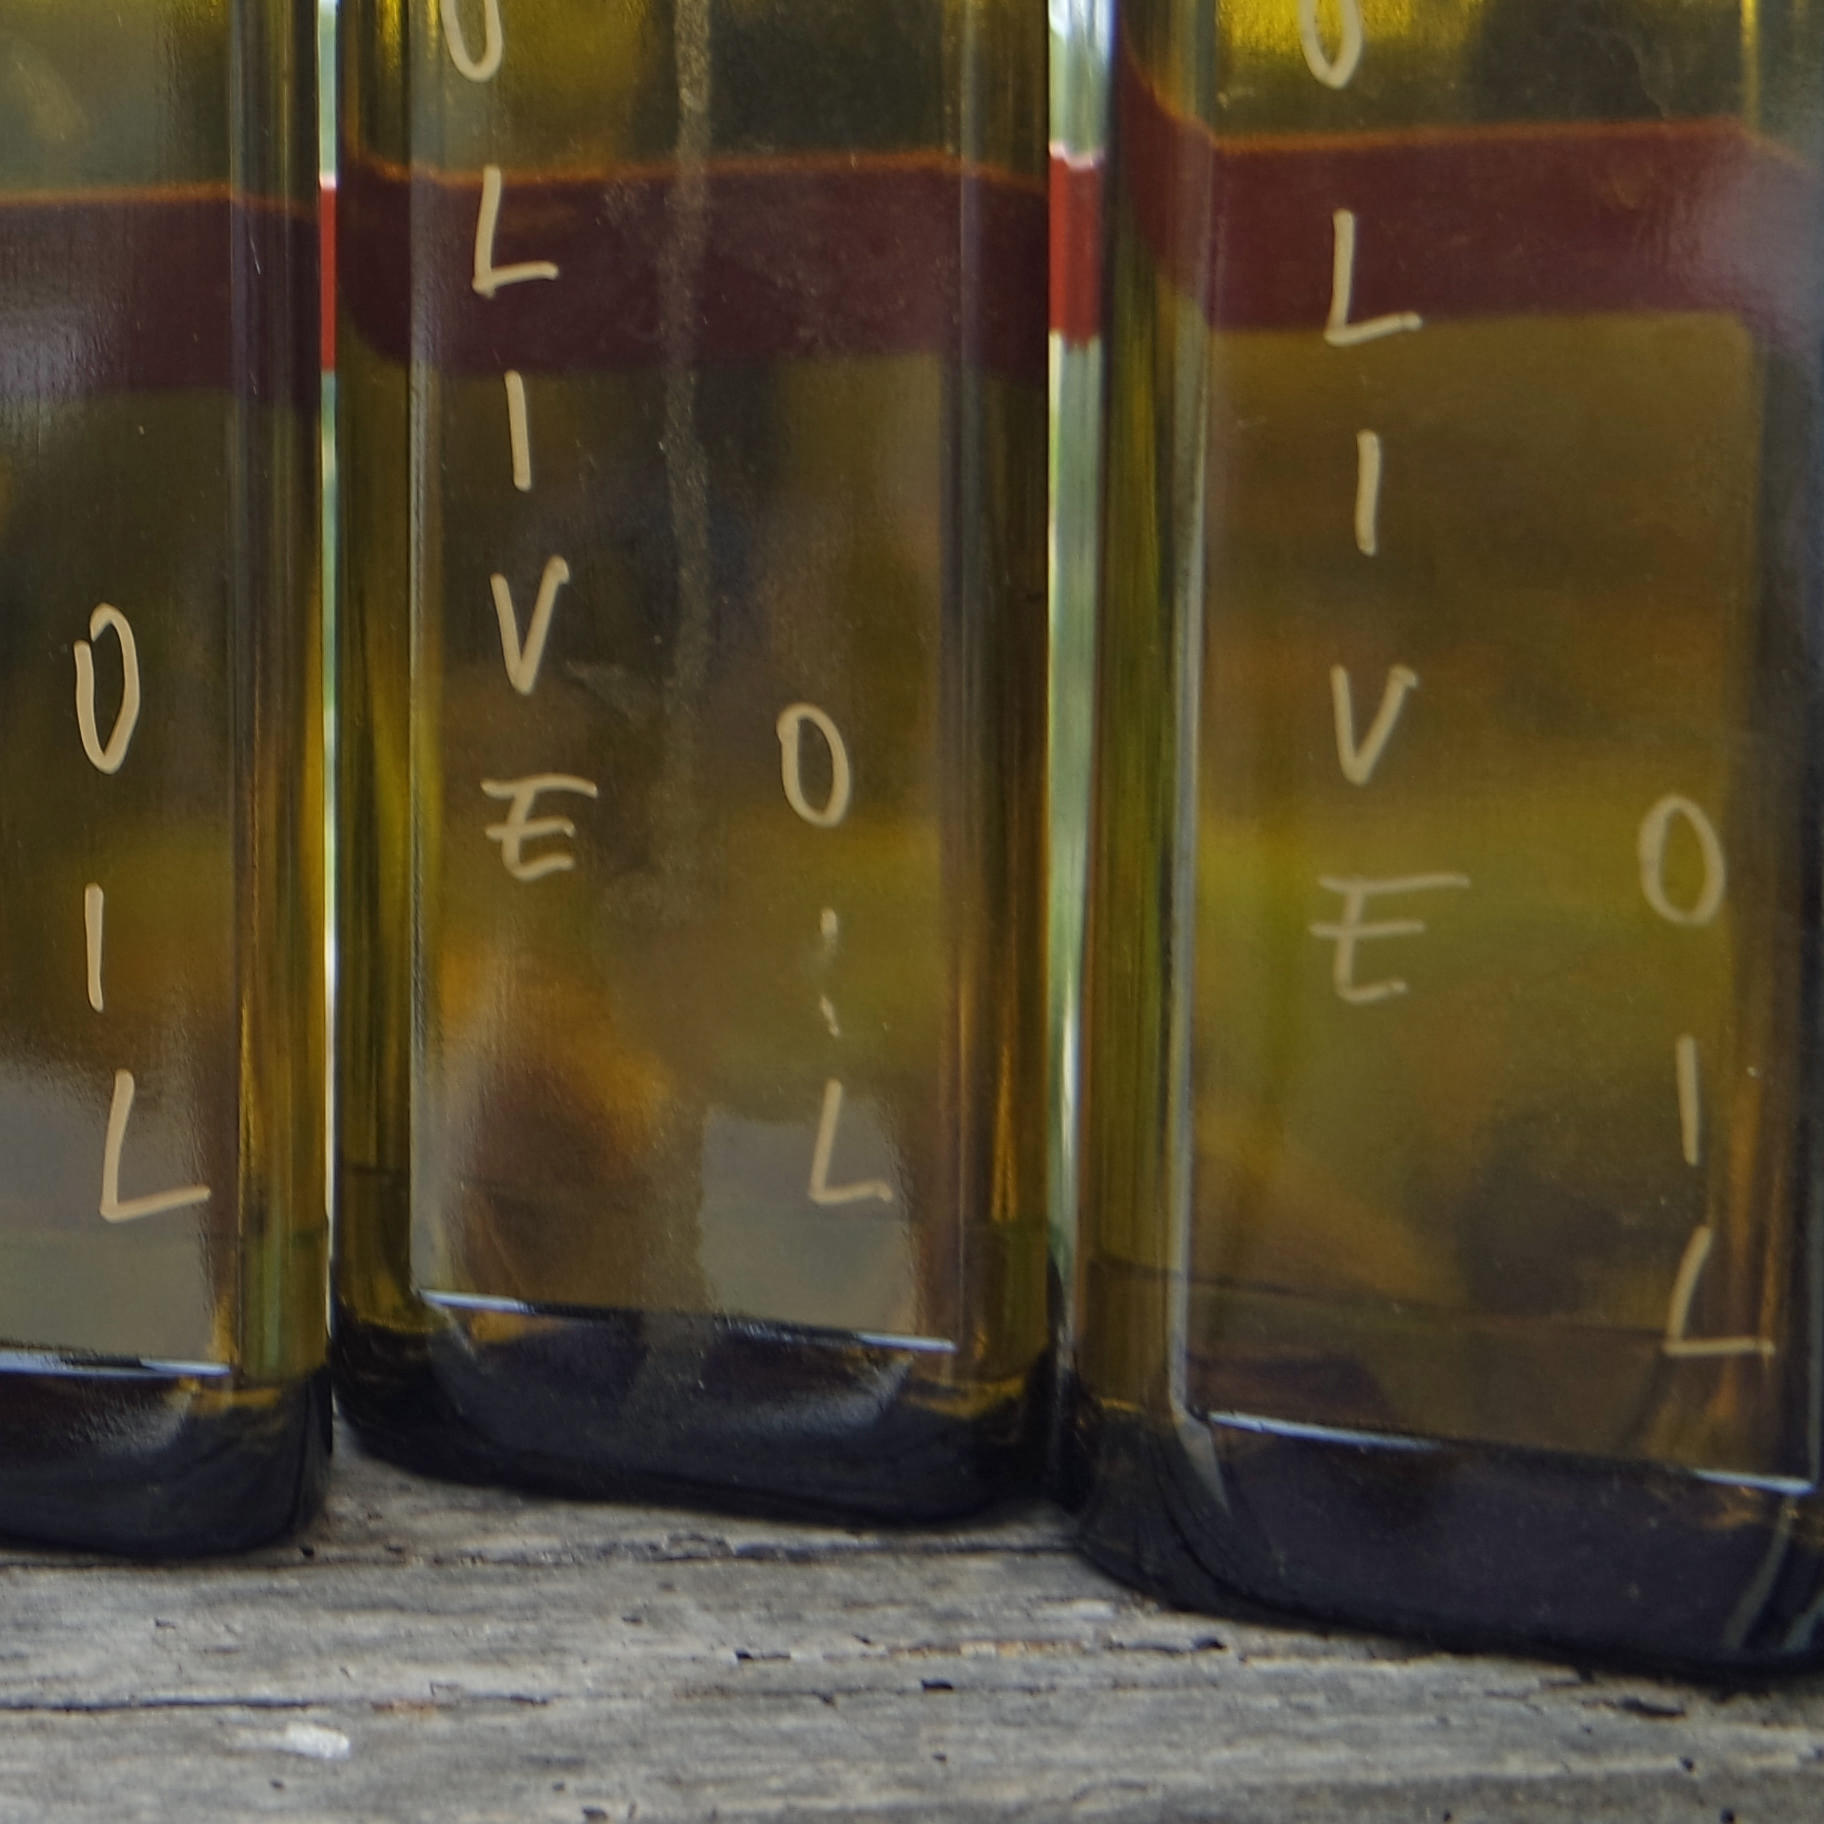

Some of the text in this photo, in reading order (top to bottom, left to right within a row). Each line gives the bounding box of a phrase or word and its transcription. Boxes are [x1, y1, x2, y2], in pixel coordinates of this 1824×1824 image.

[74, 602, 212, 1223] OIL
[777, 703, 894, 1206] OIL
[1638, 793, 1775, 1357] OIL
